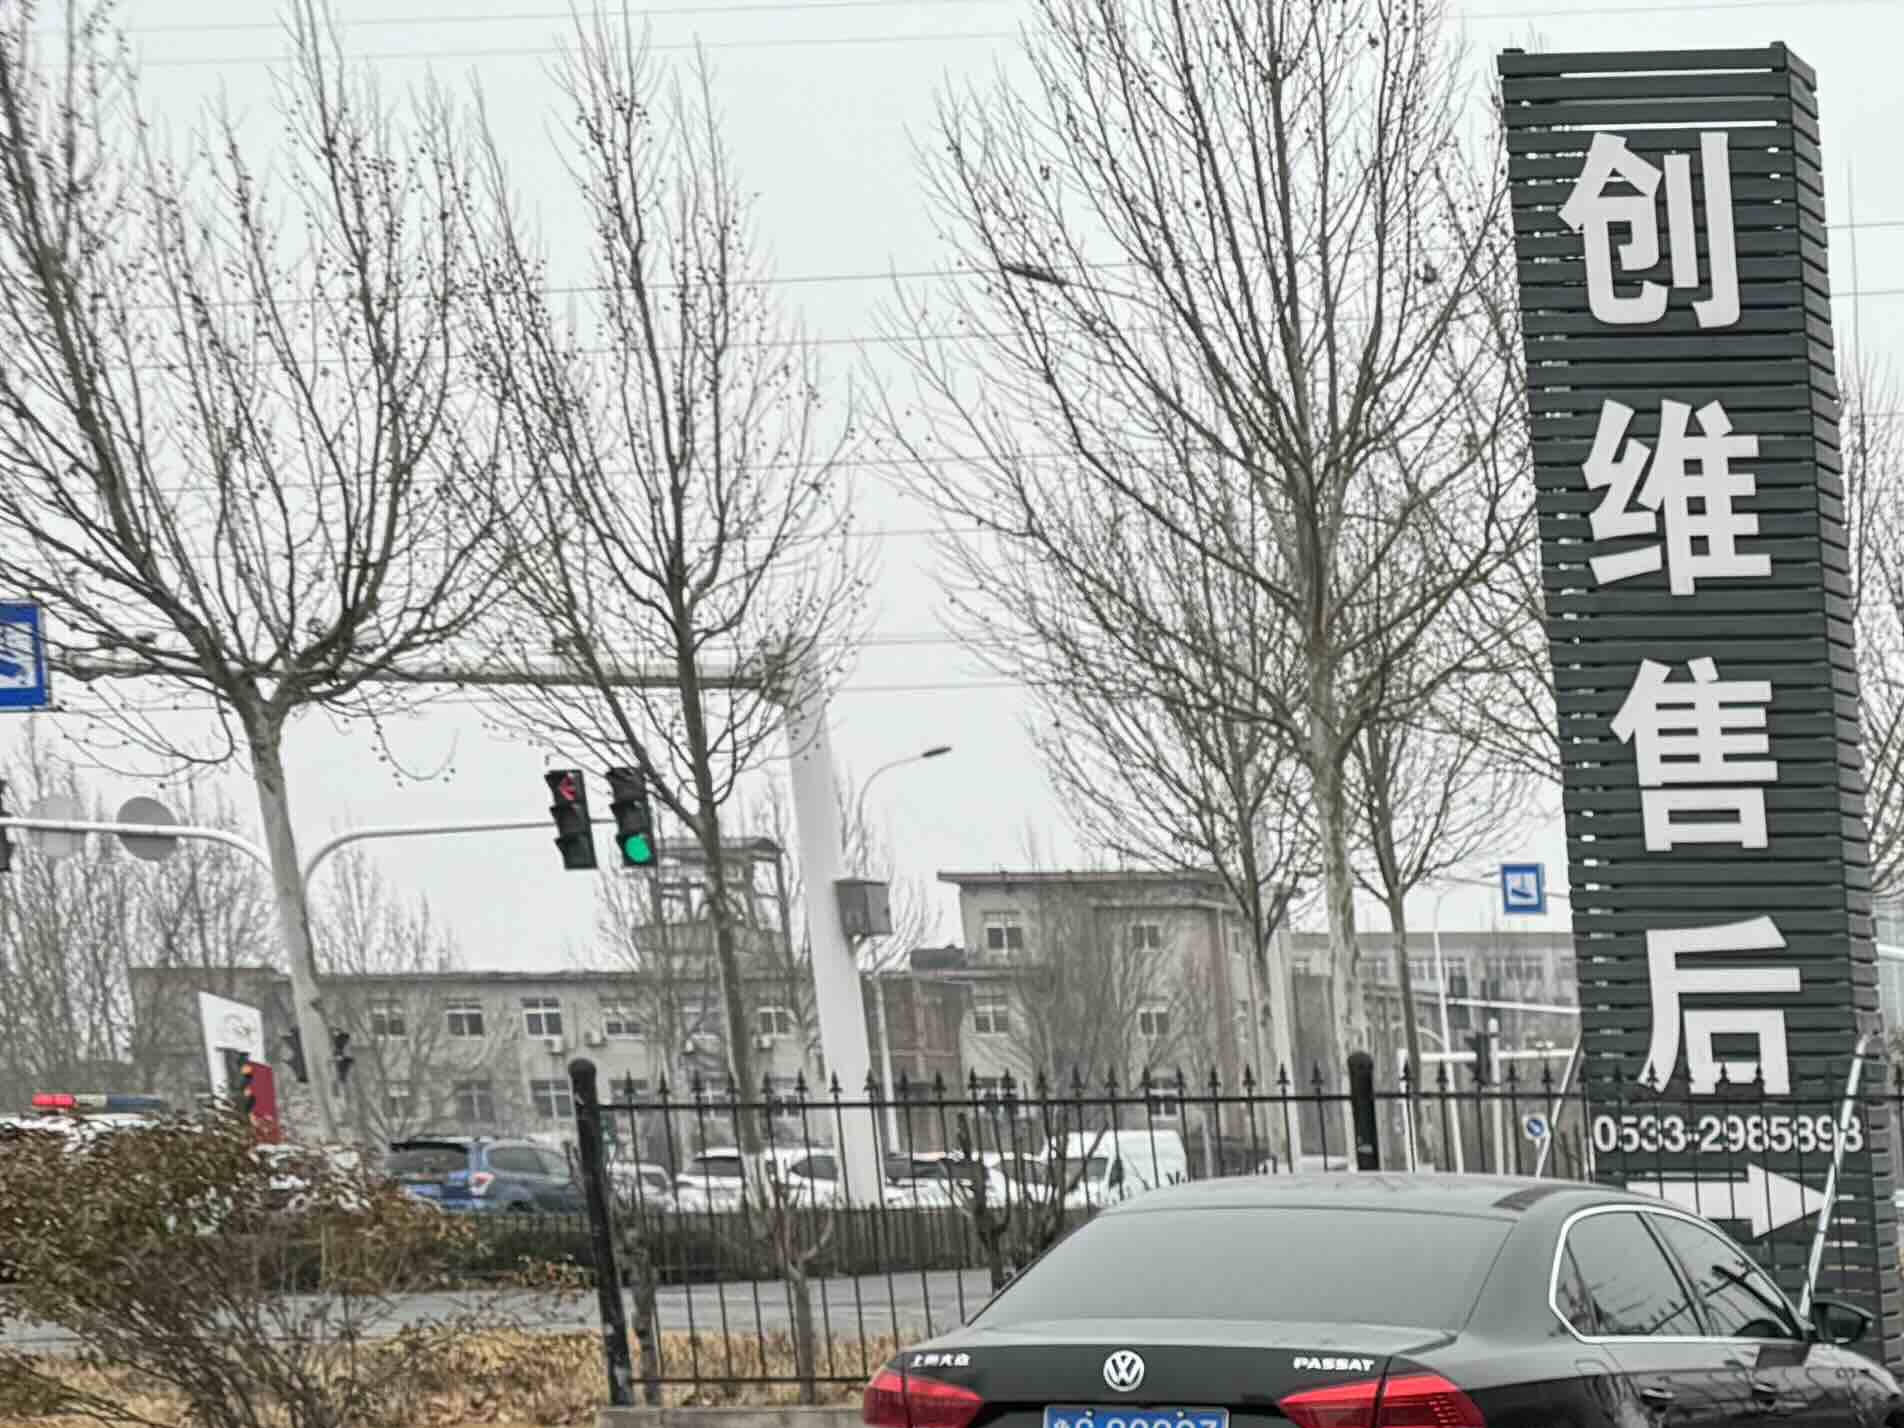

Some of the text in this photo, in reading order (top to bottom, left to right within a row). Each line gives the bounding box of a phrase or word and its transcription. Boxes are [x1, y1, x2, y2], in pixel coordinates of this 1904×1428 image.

[1558, 131, 1800, 1094] 创维售后
[1293, 1356, 1375, 1372] PASSAT
